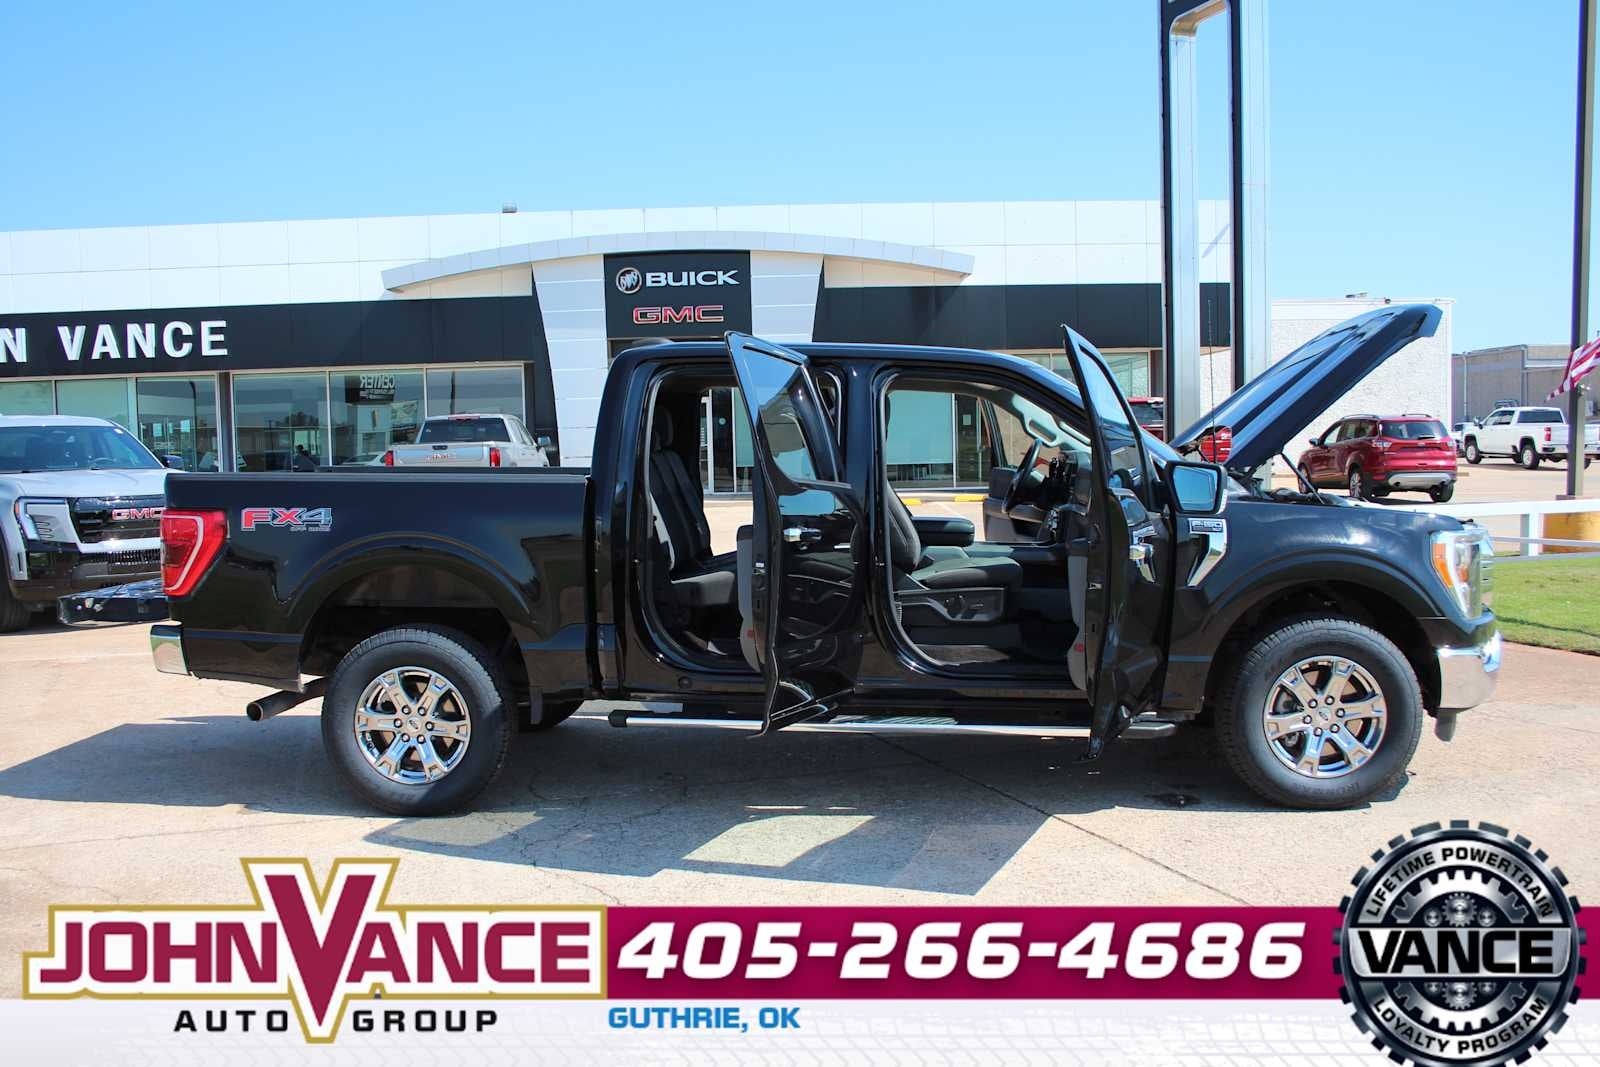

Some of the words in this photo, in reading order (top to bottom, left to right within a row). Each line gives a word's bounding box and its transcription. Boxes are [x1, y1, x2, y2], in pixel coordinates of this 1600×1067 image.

[645, 270, 740, 287] BUICK
[633, 305, 724, 324] GMC
[57, 320, 228, 361] VANCE
[241, 507, 332, 531] FX4
